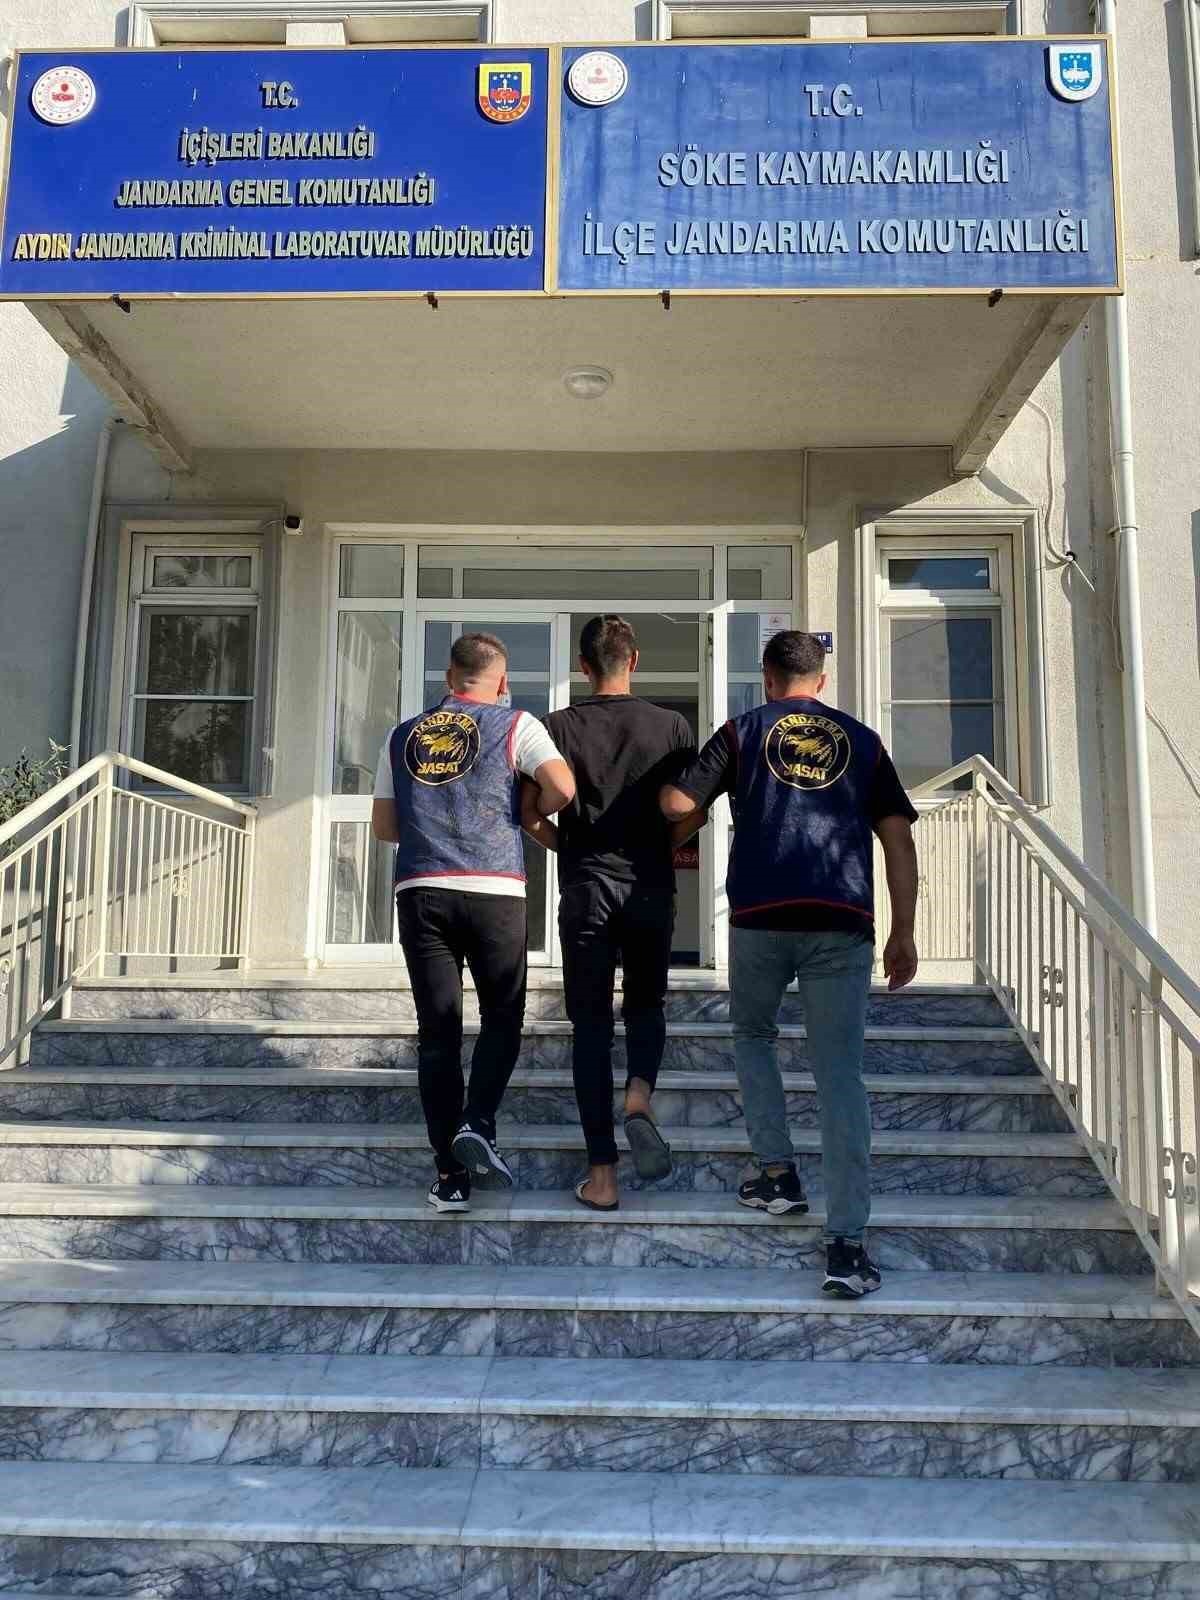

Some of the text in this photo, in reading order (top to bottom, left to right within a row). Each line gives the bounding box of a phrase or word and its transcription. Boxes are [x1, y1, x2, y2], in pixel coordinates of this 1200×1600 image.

[261, 81, 298, 107] T.C.
[804, 83, 863, 116] T.C.
[180, 125, 375, 165] İÇİŞLERİ BAKANLIĞI
[658, 140, 1009, 187] SÖKE KAYMAKAMLIĞI
[116, 172, 435, 207] JANDARMA GENEL KOMUTANLIĞI
[14, 225, 534, 260] AYDIN JANDARMA KRİMİNAL LABORATUVAR MÜDÜRLÜĞÜ
[583, 209, 1089, 265] İLÇE JANDARMA KOMUTANLIĞI
[775, 715, 844, 742] JANDARMA
[417, 761, 460, 775] JASAT
[784, 763, 828, 780] JASAT
